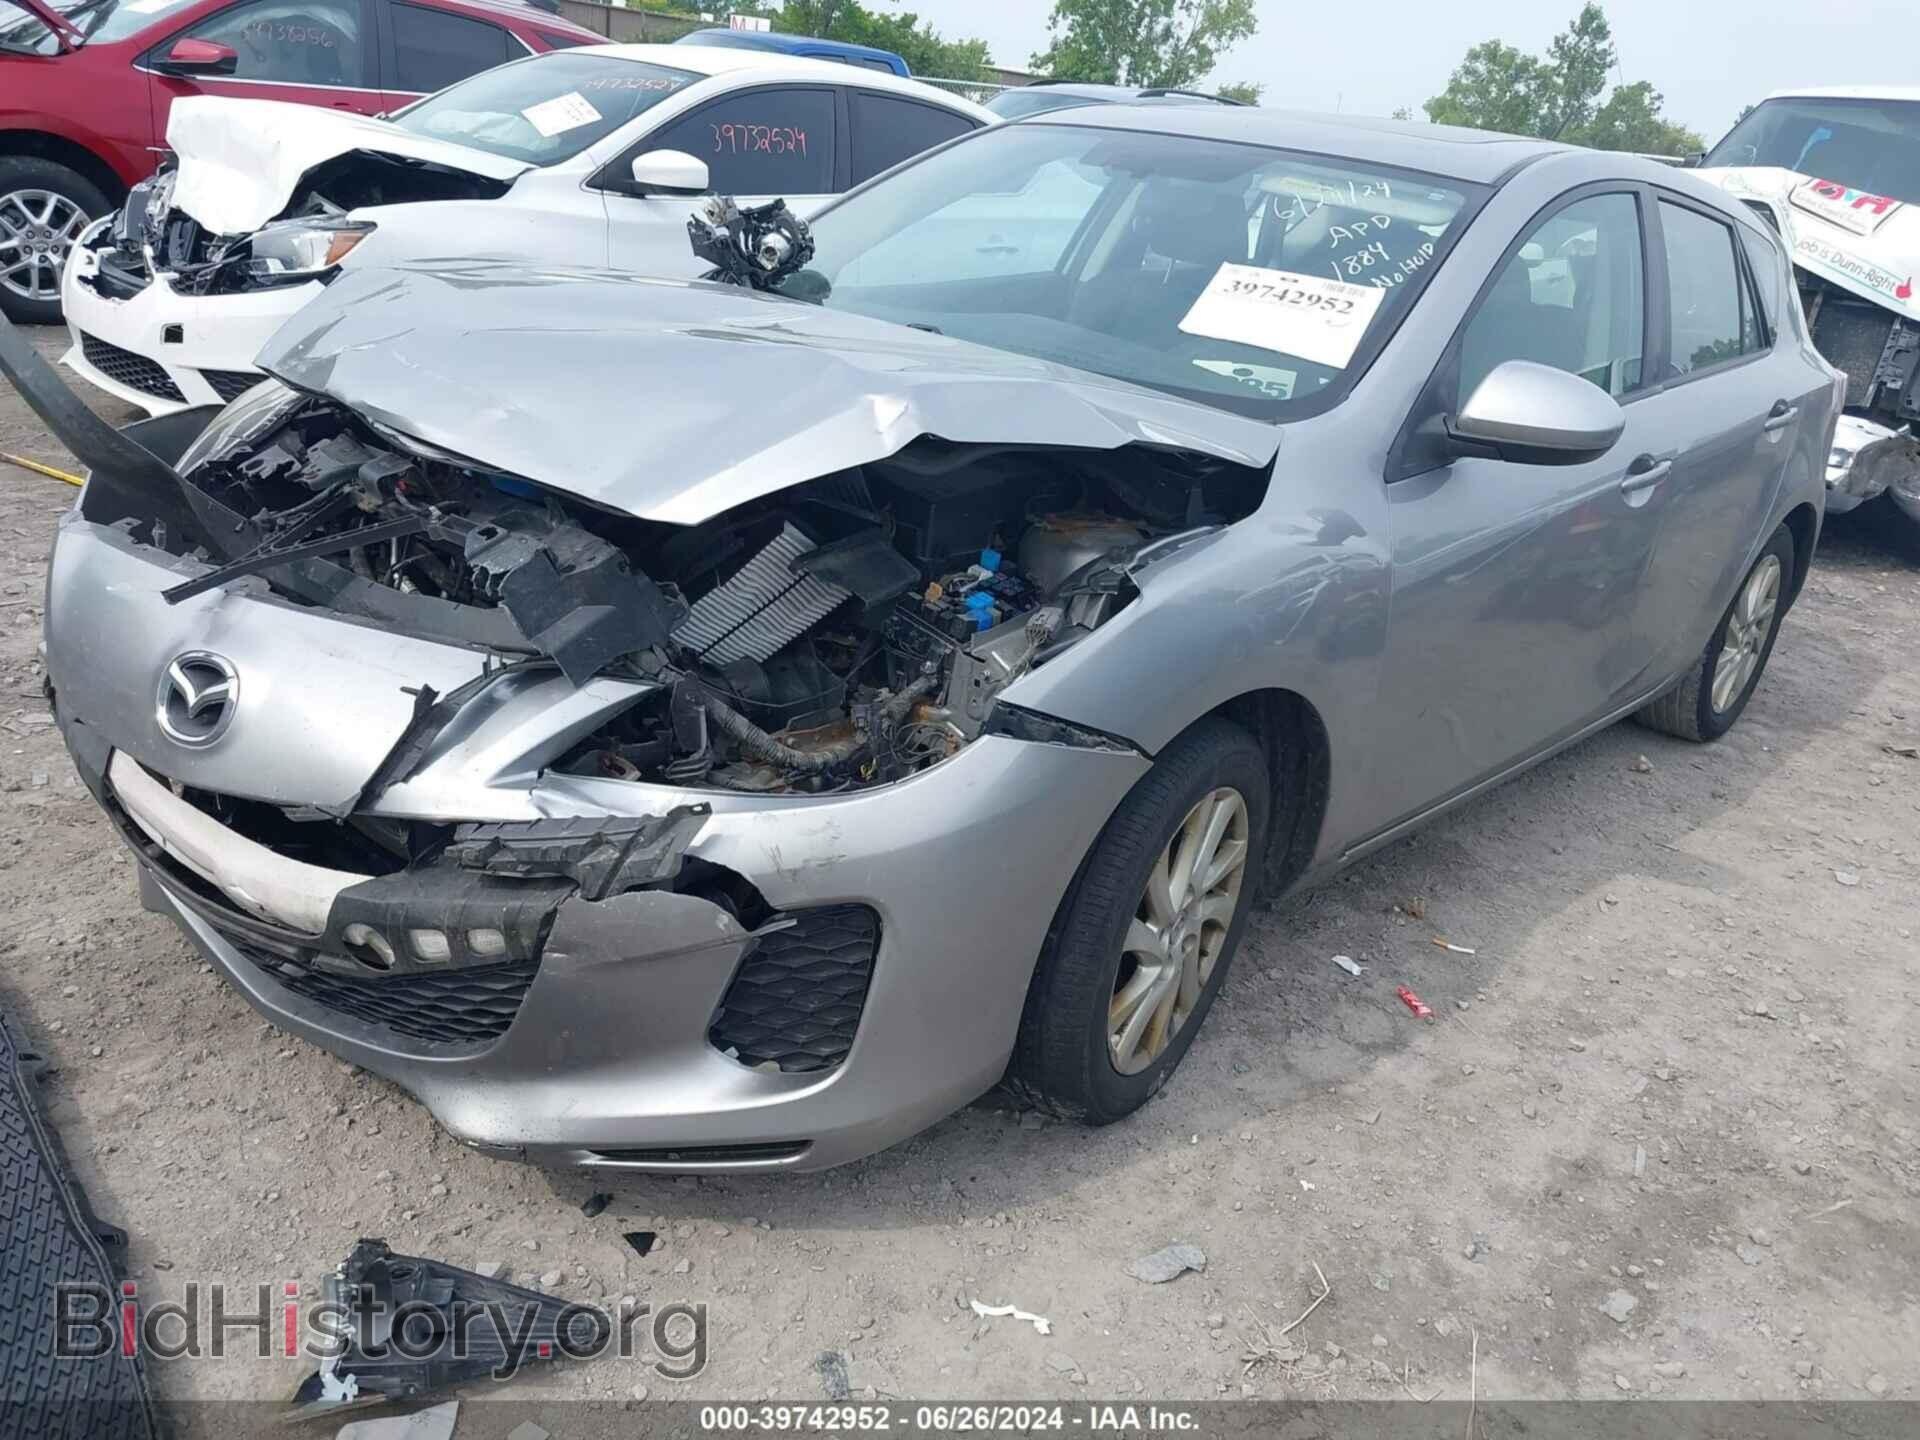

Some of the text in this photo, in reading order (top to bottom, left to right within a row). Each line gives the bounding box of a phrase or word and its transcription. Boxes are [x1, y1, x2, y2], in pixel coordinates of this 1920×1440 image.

[709, 122, 807, 160] 39732524
[1329, 214, 1391, 249] APD
[1331, 241, 1390, 282] 1884
[1830, 251, 1897, 292] Dunn-Right
[1223, 279, 1355, 316] 39742952
